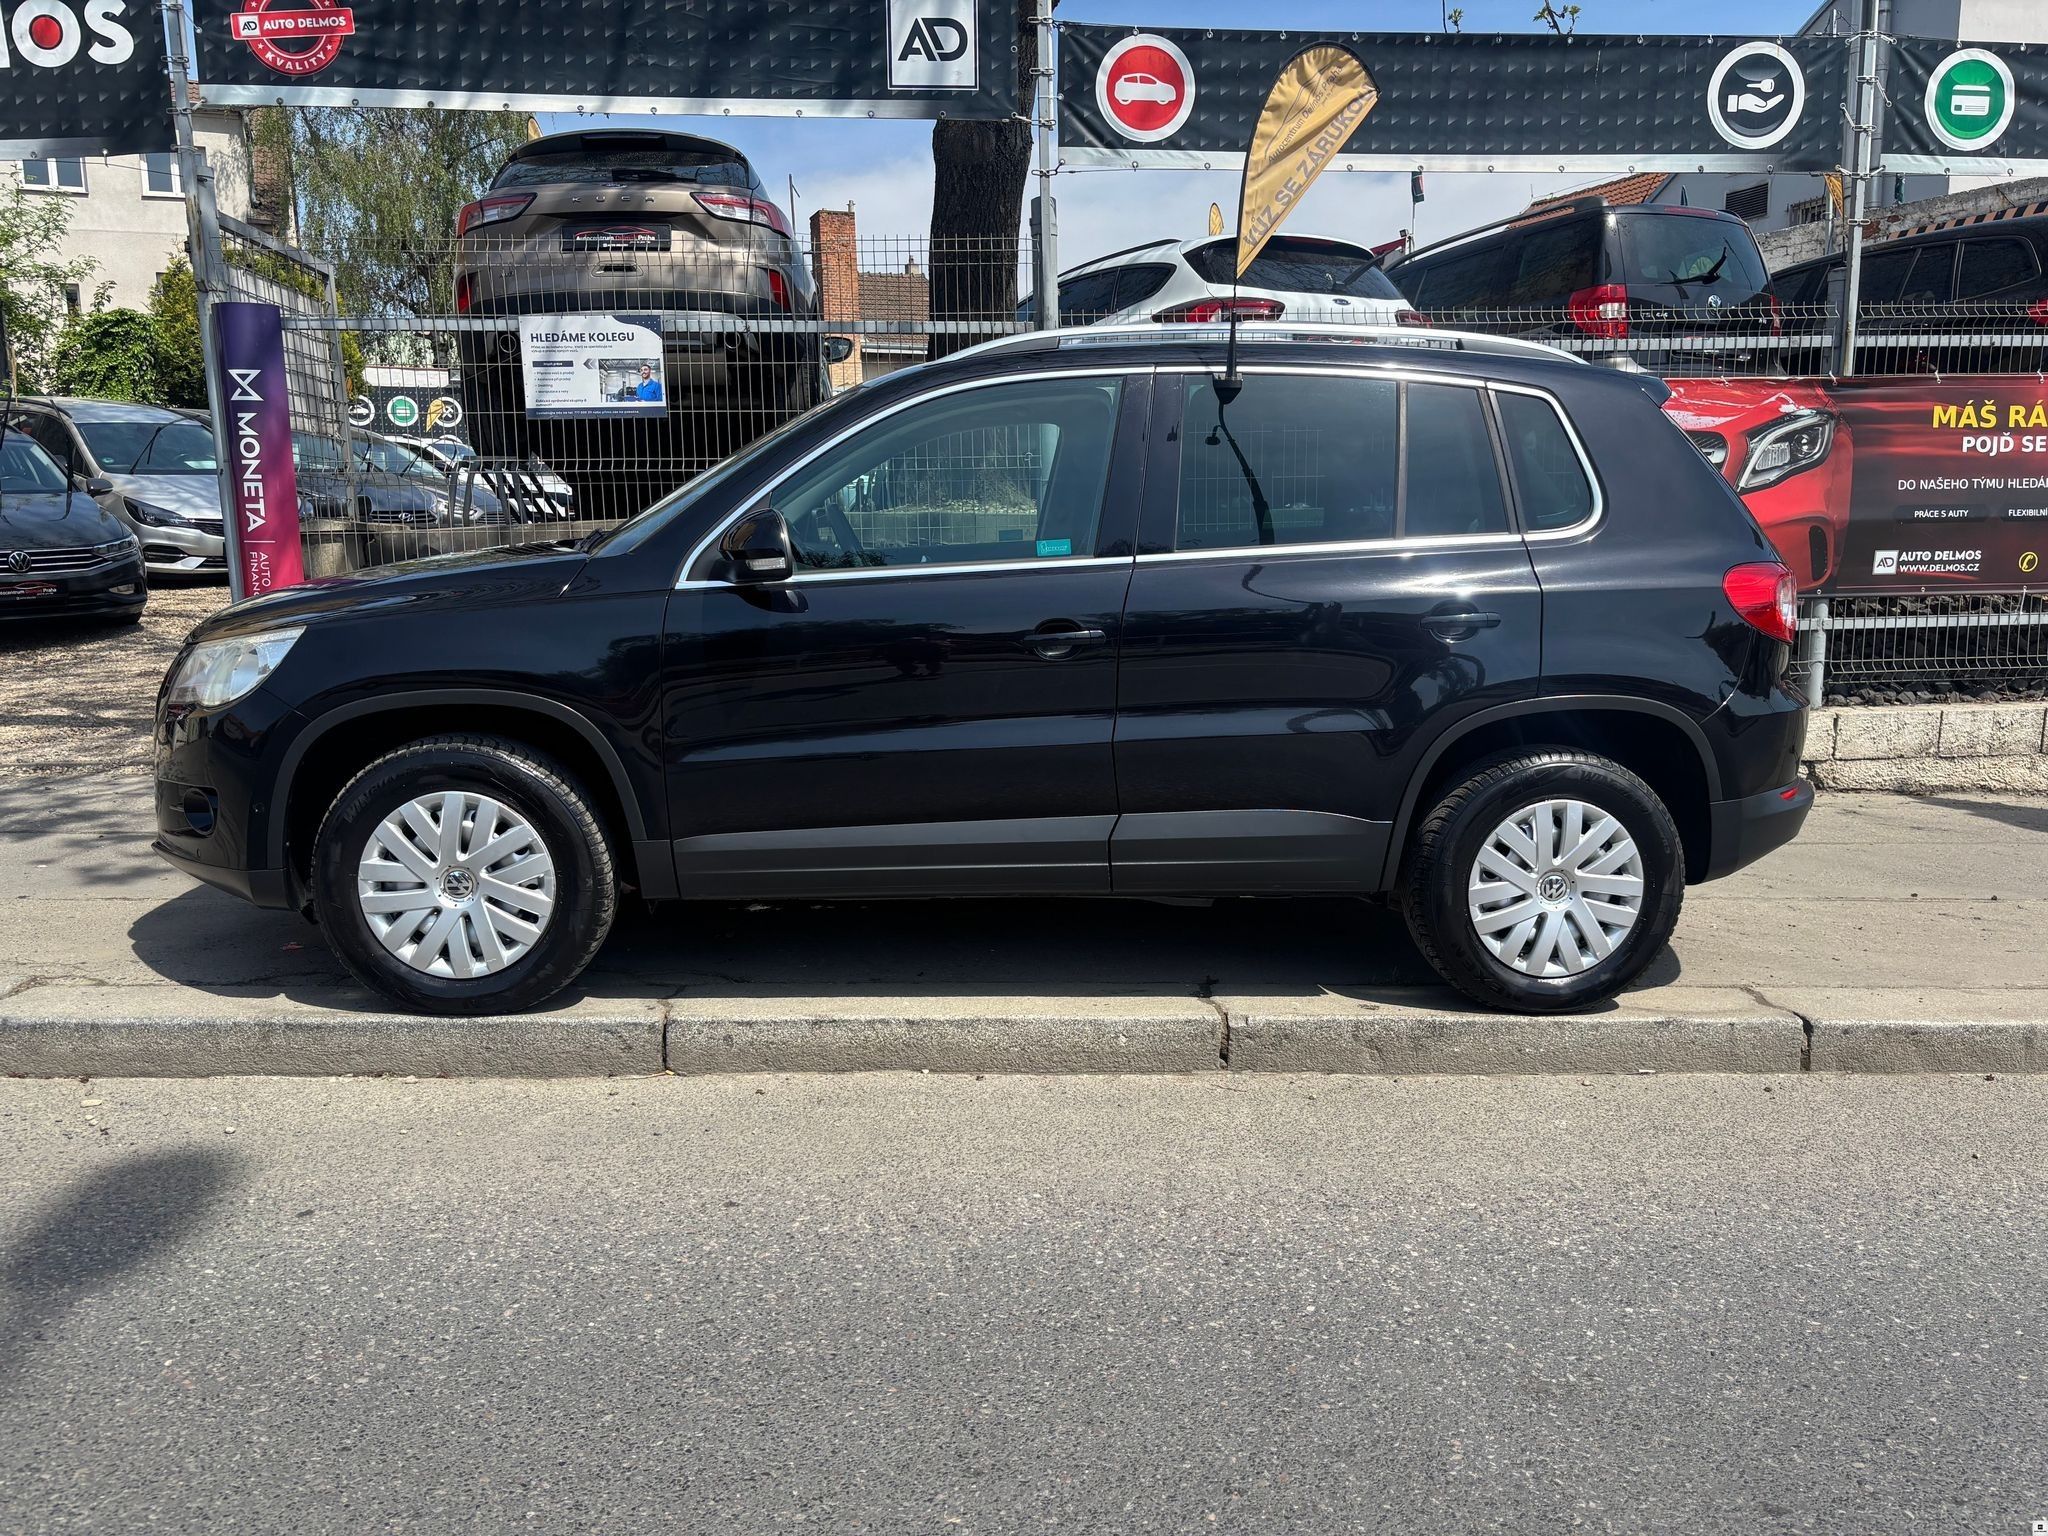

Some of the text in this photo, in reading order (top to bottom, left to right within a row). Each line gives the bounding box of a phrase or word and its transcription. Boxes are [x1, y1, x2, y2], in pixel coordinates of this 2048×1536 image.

[0, 0, 134, 68] OS
[263, 16, 347, 30] AUTO DELMOS
[898, 17, 968, 61] AD
[265, 51, 326, 70] KVALITY
[1267, 116, 1305, 163] Autocentrum
[1302, 90, 1324, 118] Delmos
[1275, 177, 1304, 207] SE
[530, 330, 635, 342] HLEDÁME KOLEGU
[1932, 399, 1997, 428] MÁŠ
[1962, 431, 2047, 456] POJĎ SE
[237, 412, 266, 532] MONETA
[1898, 475, 2048, 490] DO NAŠEHO TÝMU HLEDÁ
[1914, 508, 1939, 518] PRÁCE
[1941, 510, 1947, 518] S
[2008, 507, 2048, 517] FLEXIBILNÍ
[1899, 550, 1982, 562] AUTO DELMOS
[259, 552, 271, 587] AUTO
[1899, 563, 1980, 572] WWW.DELMOS.CZ
